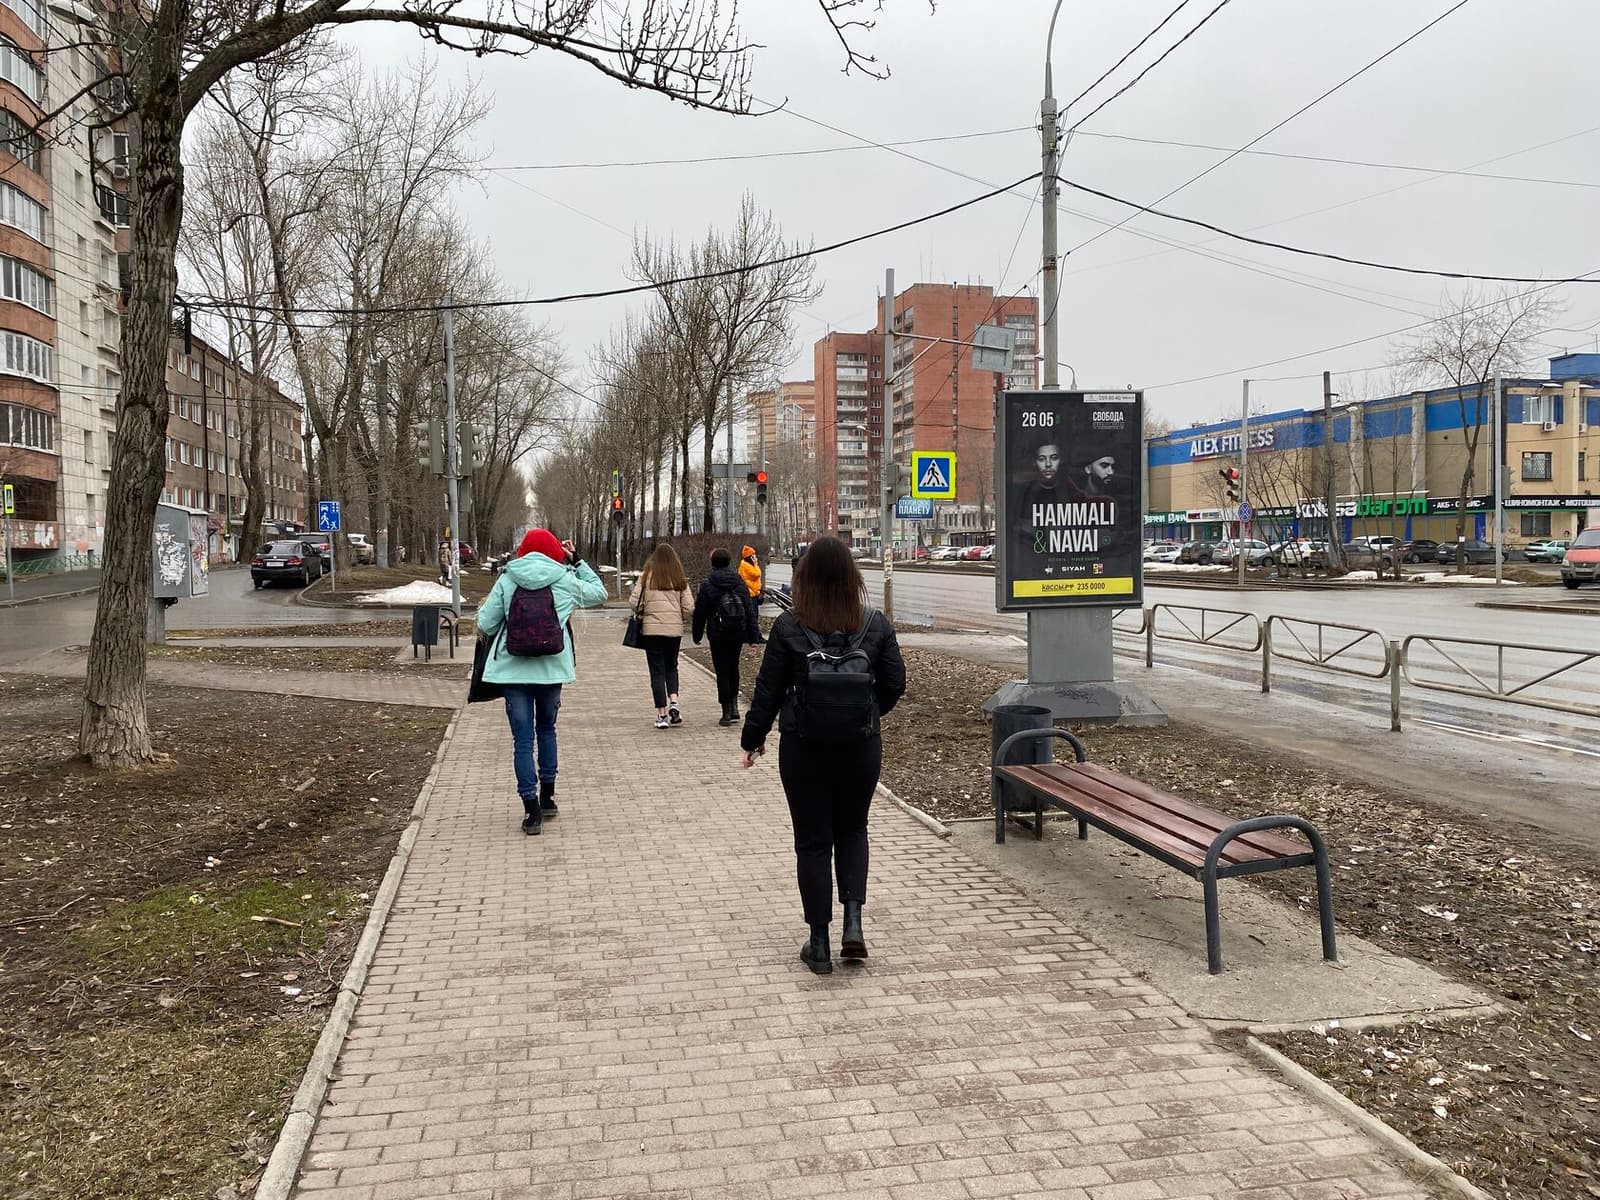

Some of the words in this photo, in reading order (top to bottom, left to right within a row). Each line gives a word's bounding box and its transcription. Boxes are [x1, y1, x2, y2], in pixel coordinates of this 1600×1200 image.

[1022, 411, 1037, 427] 26
[1039, 411, 1054, 427] 05
[1092, 411, 1124, 421] СВОБОДА
[1190, 437, 1219, 456] ALEX
[1221, 427, 1274, 451] FITESS
[898, 505, 931, 514] ПЛАНЕТУ
[1504, 499, 1561, 507] ШИНОМОНТАЖ
[1032, 502, 1115, 527] HAMMALI
[1033, 529, 1048, 553] &
[1049, 529, 1098, 553] NAVAI
[1077, 583, 1089, 591] 235
[1090, 582, 1106, 590] 0000
